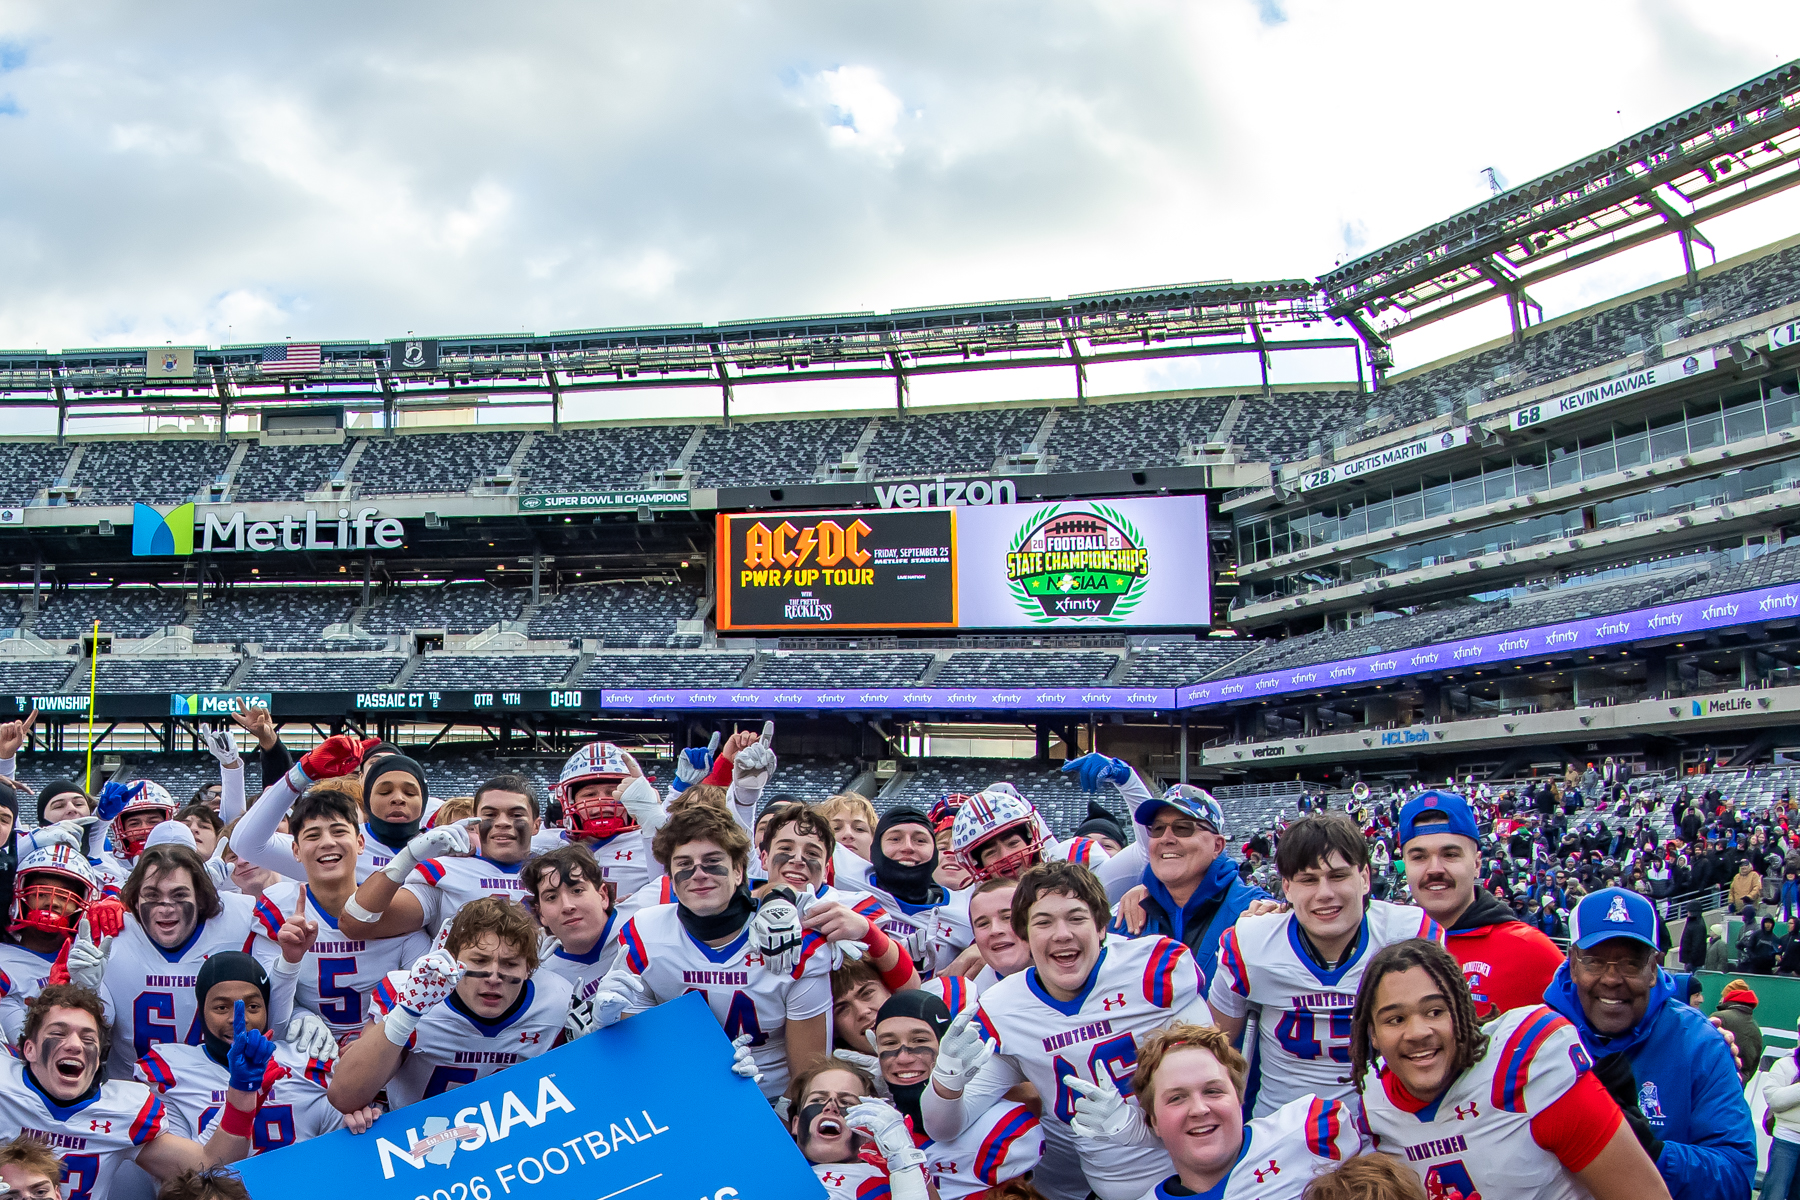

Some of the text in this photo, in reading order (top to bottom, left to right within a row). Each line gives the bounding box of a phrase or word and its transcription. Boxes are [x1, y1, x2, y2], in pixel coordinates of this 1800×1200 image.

[1517, 369, 1656, 426] 68 KEVIN MAWAE
[1310, 440, 1428, 486] 28 CURTIS MARTIN
[545, 493, 688, 507] SUPER BOWL III CHAMPIONS
[873, 476, 1016, 509] verizon
[202, 507, 405, 552] MetLife
[1032, 535, 1120, 551] 20 FOOTBALL 25
[874, 547, 949, 560] FRIDAY, SEPTEMBER 25
[1007, 549, 1148, 578] STATE CHAMPIONSHIPS
[822, 568, 875, 586] TOUR
[784, 605, 832, 621] RECKLESS
[1055, 598, 1101, 613] xfinity
[1188, 602, 1739, 701] xfinity xfinity xfinity
[15, 696, 27, 704] TOL
[31, 696, 92, 710] TOWNSHIP
[356, 692, 424, 708] PASSAIC CT
[429, 692, 441, 700] TOL
[432, 700, 439, 708] 2
[474, 693, 521, 707] QTR 4TH
[550, 690, 582, 708] 0:00
[605, 692, 1112, 705] xfinity xfinity xfinity
[1708, 696, 1752, 714] MetLife
[1381, 728, 1429, 746] HCLTech
[1252, 744, 1285, 758] verizon
[309, 940, 366, 953] MINUTEMEN
[145, 974, 198, 988] MINUTEME
[683, 970, 749, 985] MINUTEMEN
[317, 956, 363, 1026] 5
[1291, 991, 1356, 1008] MINUTEME
[1042, 1019, 1113, 1053] MINUTEMEN
[454, 1051, 518, 1064] MINUTEMEN
[425, 1130, 459, 1147] Est. 1918
[495, 1109, 669, 1189] FOOTBALL
[1405, 1134, 1469, 1162] MINUTEMEN
